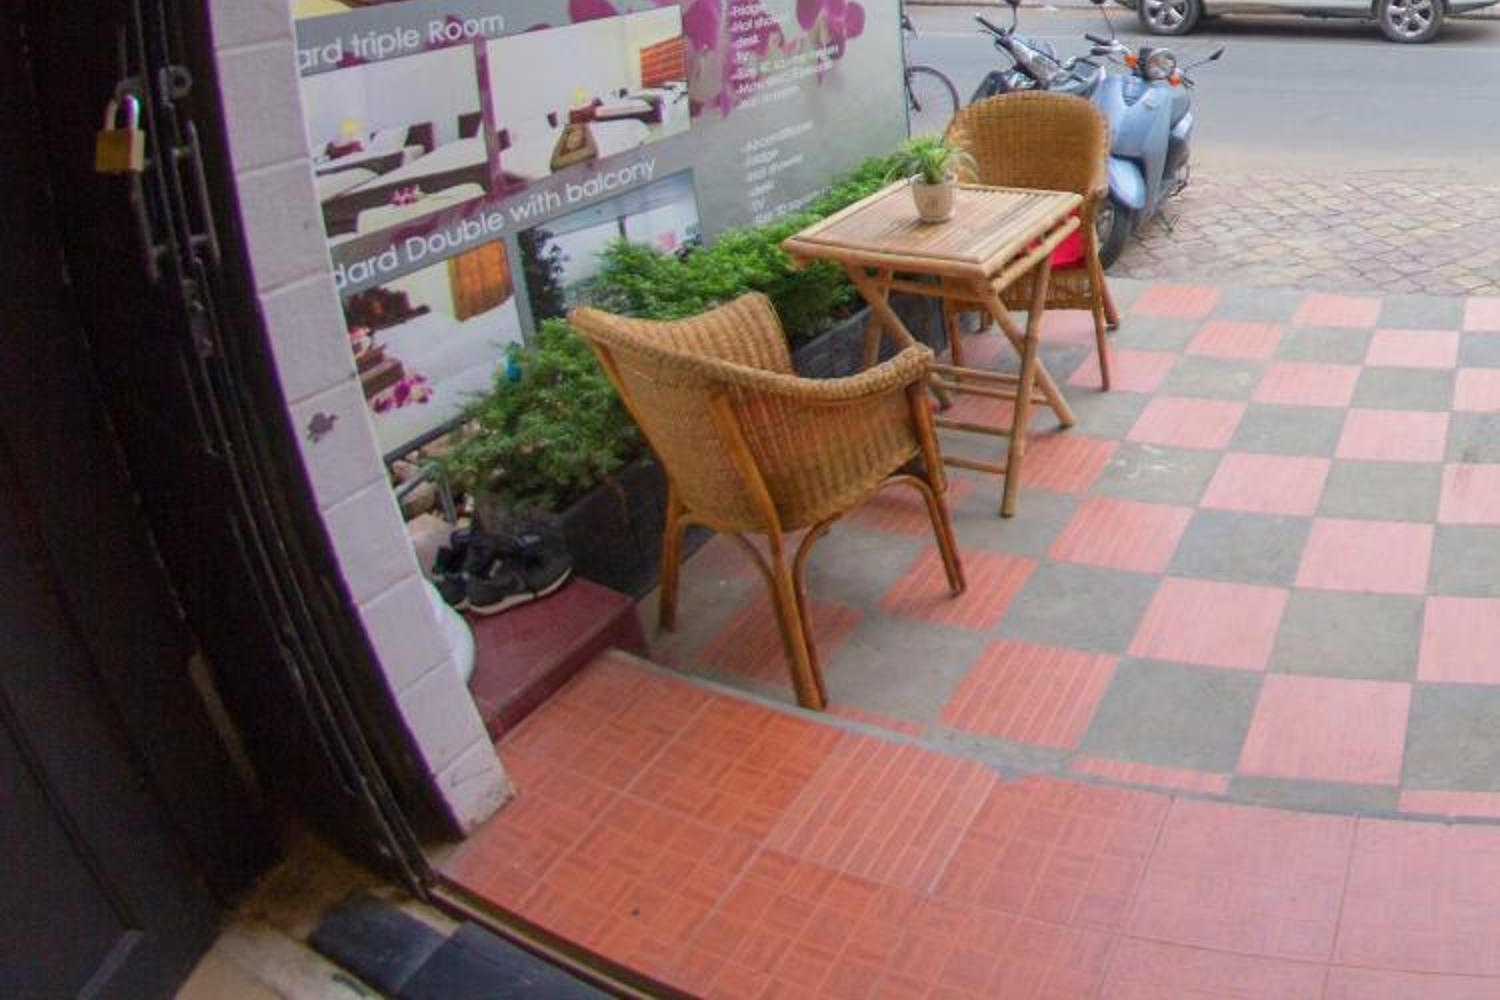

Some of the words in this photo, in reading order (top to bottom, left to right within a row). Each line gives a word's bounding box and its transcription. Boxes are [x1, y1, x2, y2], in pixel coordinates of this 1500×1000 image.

[350, 25, 420, 59] triple
[428, 14, 505, 44] Room
[404, 211, 503, 263] Double
[509, 188, 561, 228] with
[566, 155, 657, 202] balcony
